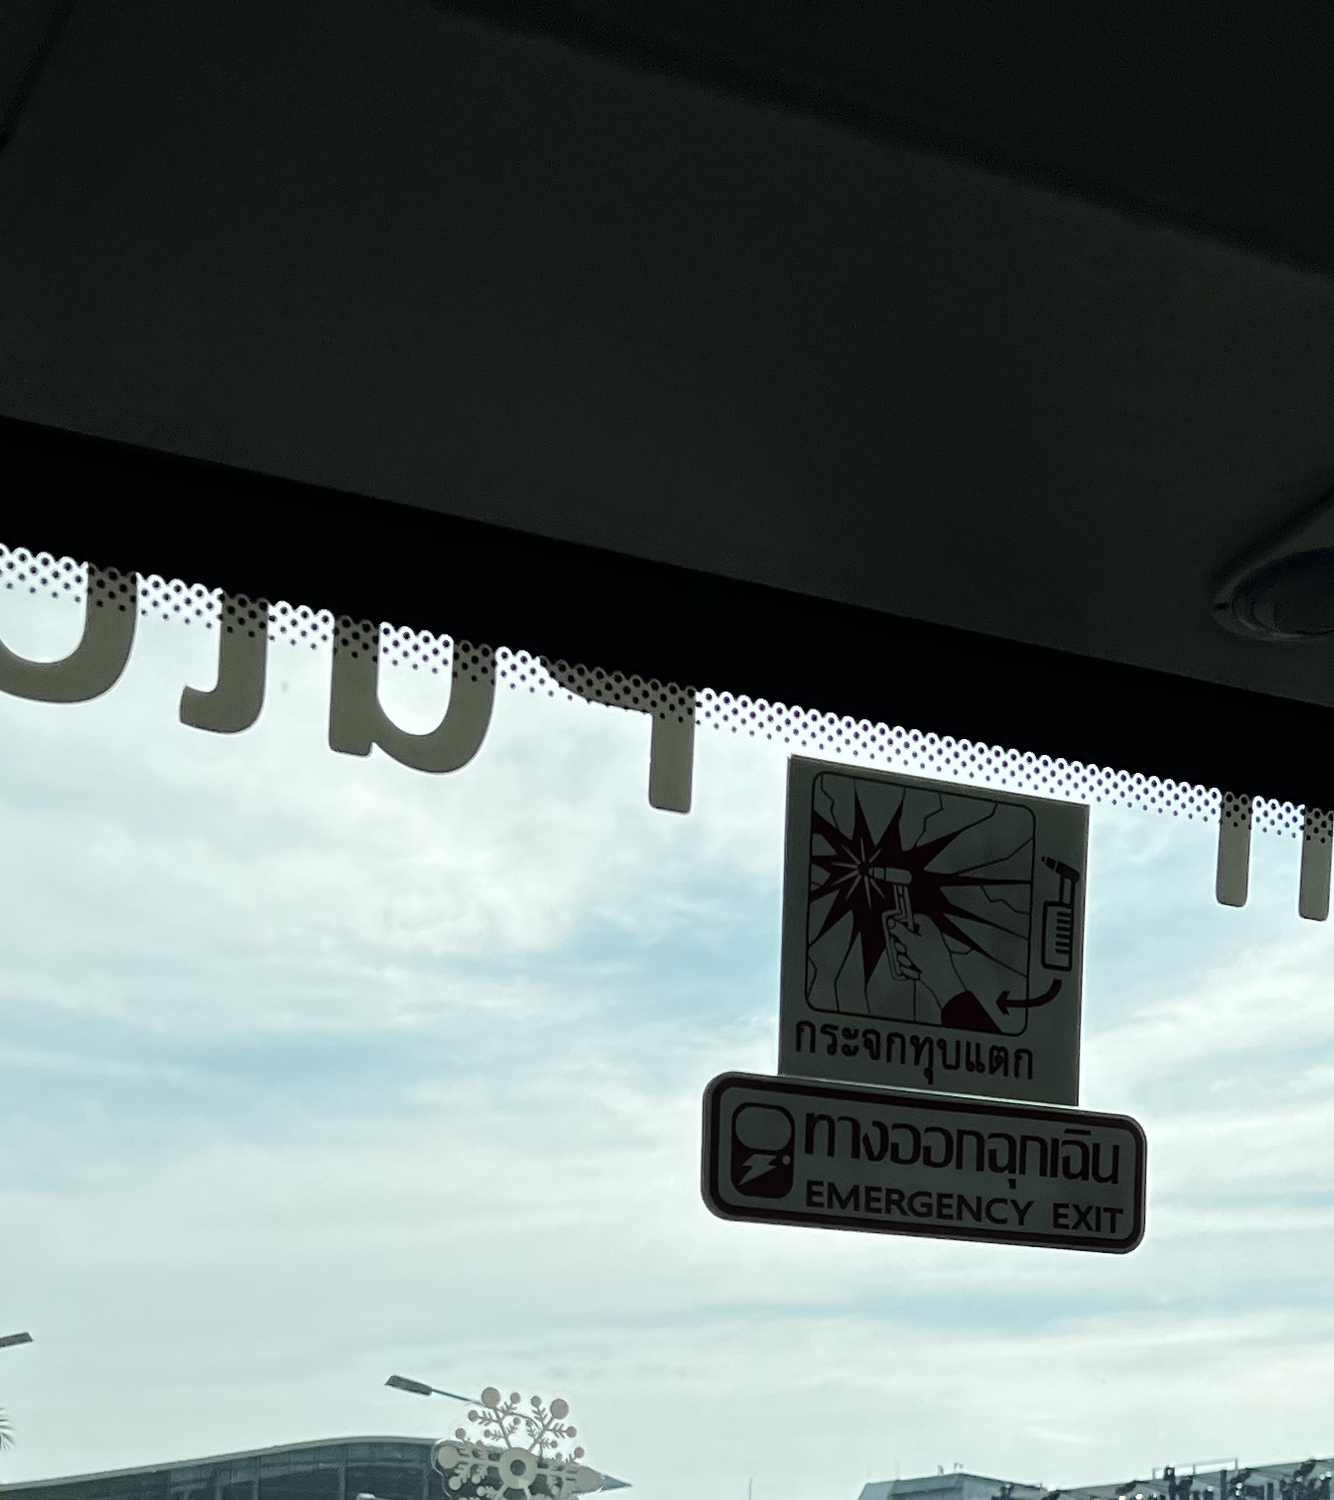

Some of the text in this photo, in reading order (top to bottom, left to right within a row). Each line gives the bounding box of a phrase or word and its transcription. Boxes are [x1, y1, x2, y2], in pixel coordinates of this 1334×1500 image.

[794, 1019, 1034, 1086] กระจกทุบแตก
[804, 1111, 1121, 1190] ทางออกฉุกเฉิน
[805, 1178, 1124, 1234] EMERGENCY EXIT
